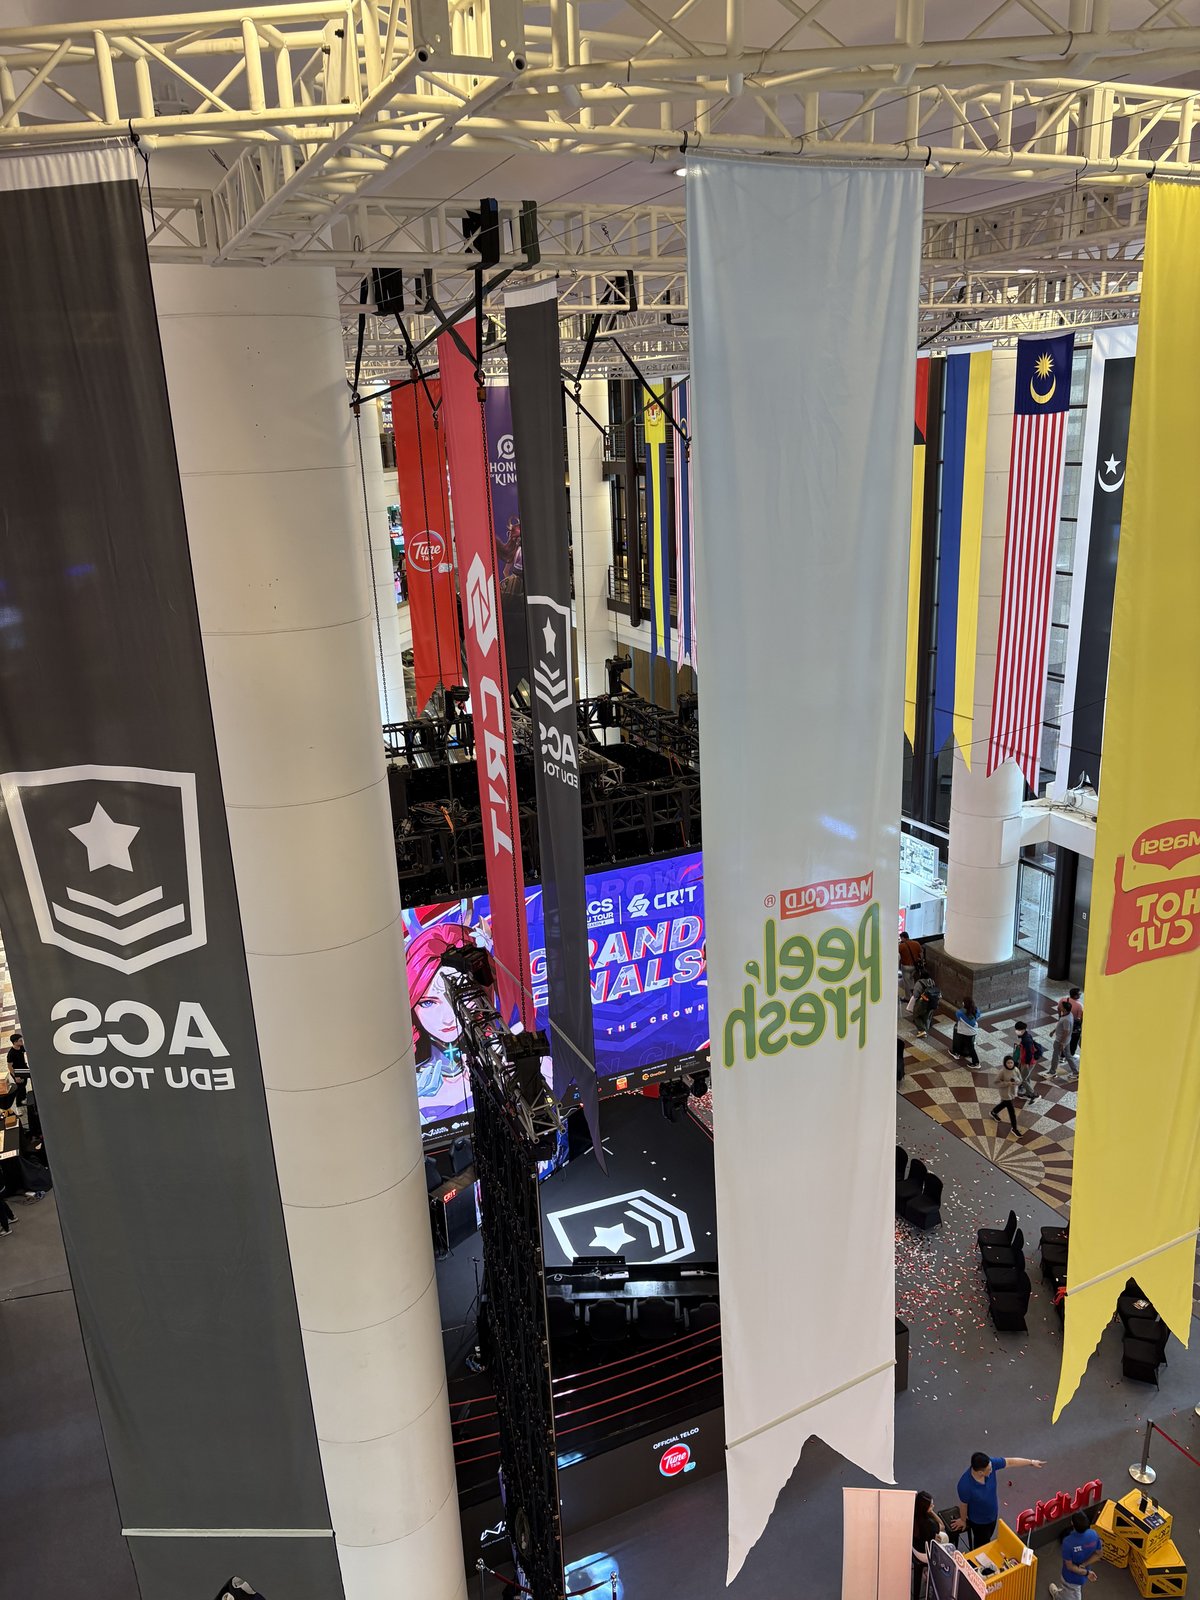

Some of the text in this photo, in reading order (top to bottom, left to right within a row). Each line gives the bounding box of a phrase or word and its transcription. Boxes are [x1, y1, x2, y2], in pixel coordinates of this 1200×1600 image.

[412, 541, 441, 560] Tune
[587, 898, 614, 917] CS
[595, 911, 614, 922] TOUR
[533, 949, 704, 1007] NALS
[606, 1003, 705, 1035] THE CROWN
[653, 1427, 699, 1449] OFFICIAL TELCO
[664, 1452, 687, 1469] Tune
